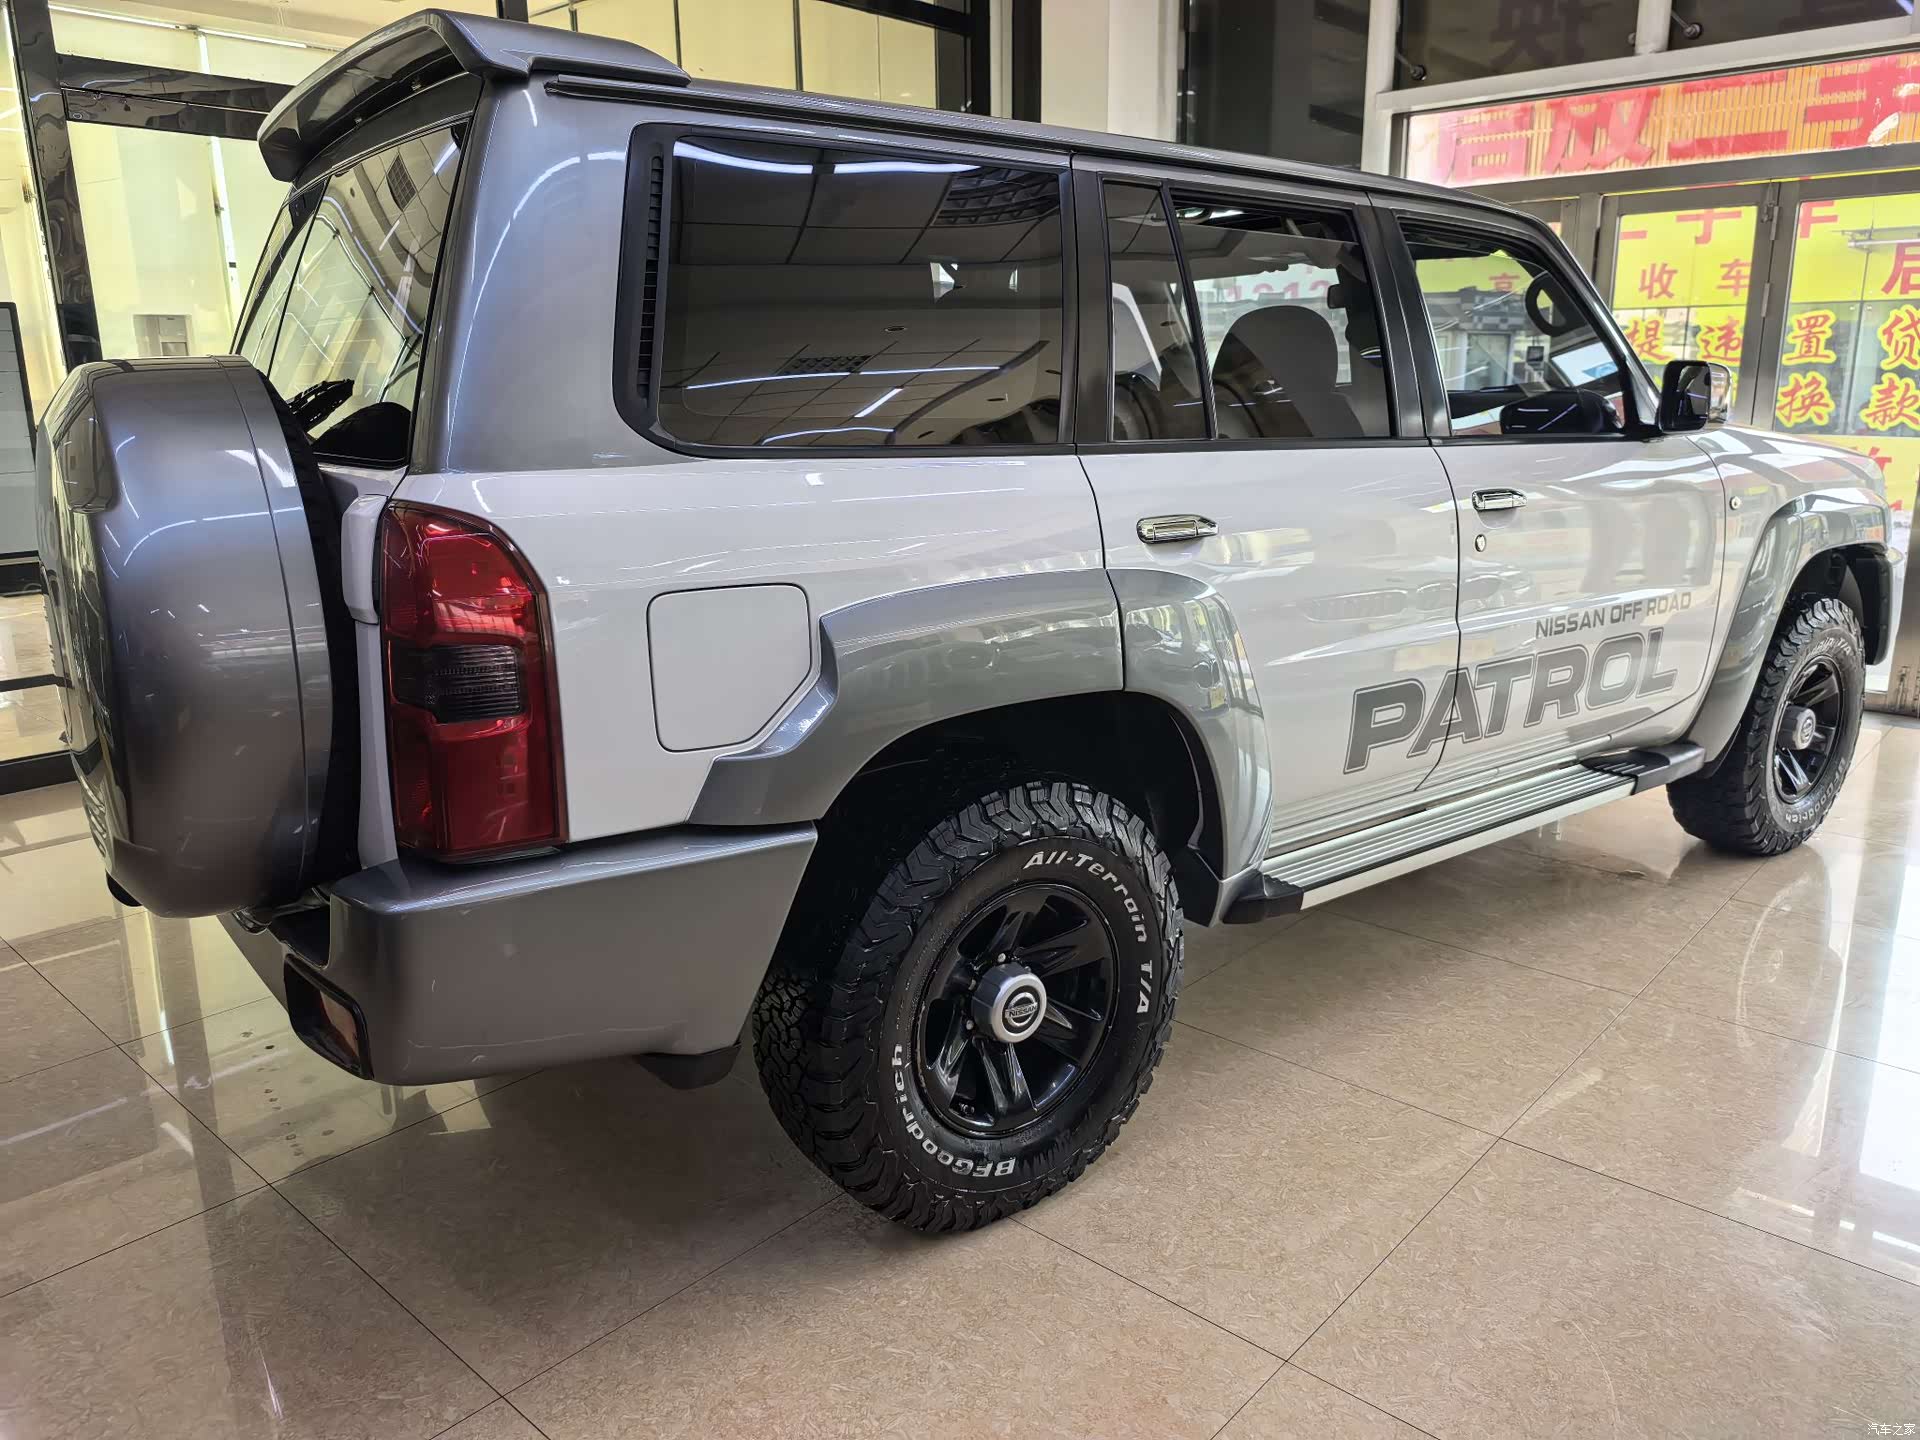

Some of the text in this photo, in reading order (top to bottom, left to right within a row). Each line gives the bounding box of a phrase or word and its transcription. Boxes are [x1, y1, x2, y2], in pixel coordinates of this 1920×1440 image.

[1535, 591, 1693, 639] NISSAN OFF ROAD
[1342, 627, 1679, 775] PATROL
[1022, 850, 1148, 943] All-Terrain
